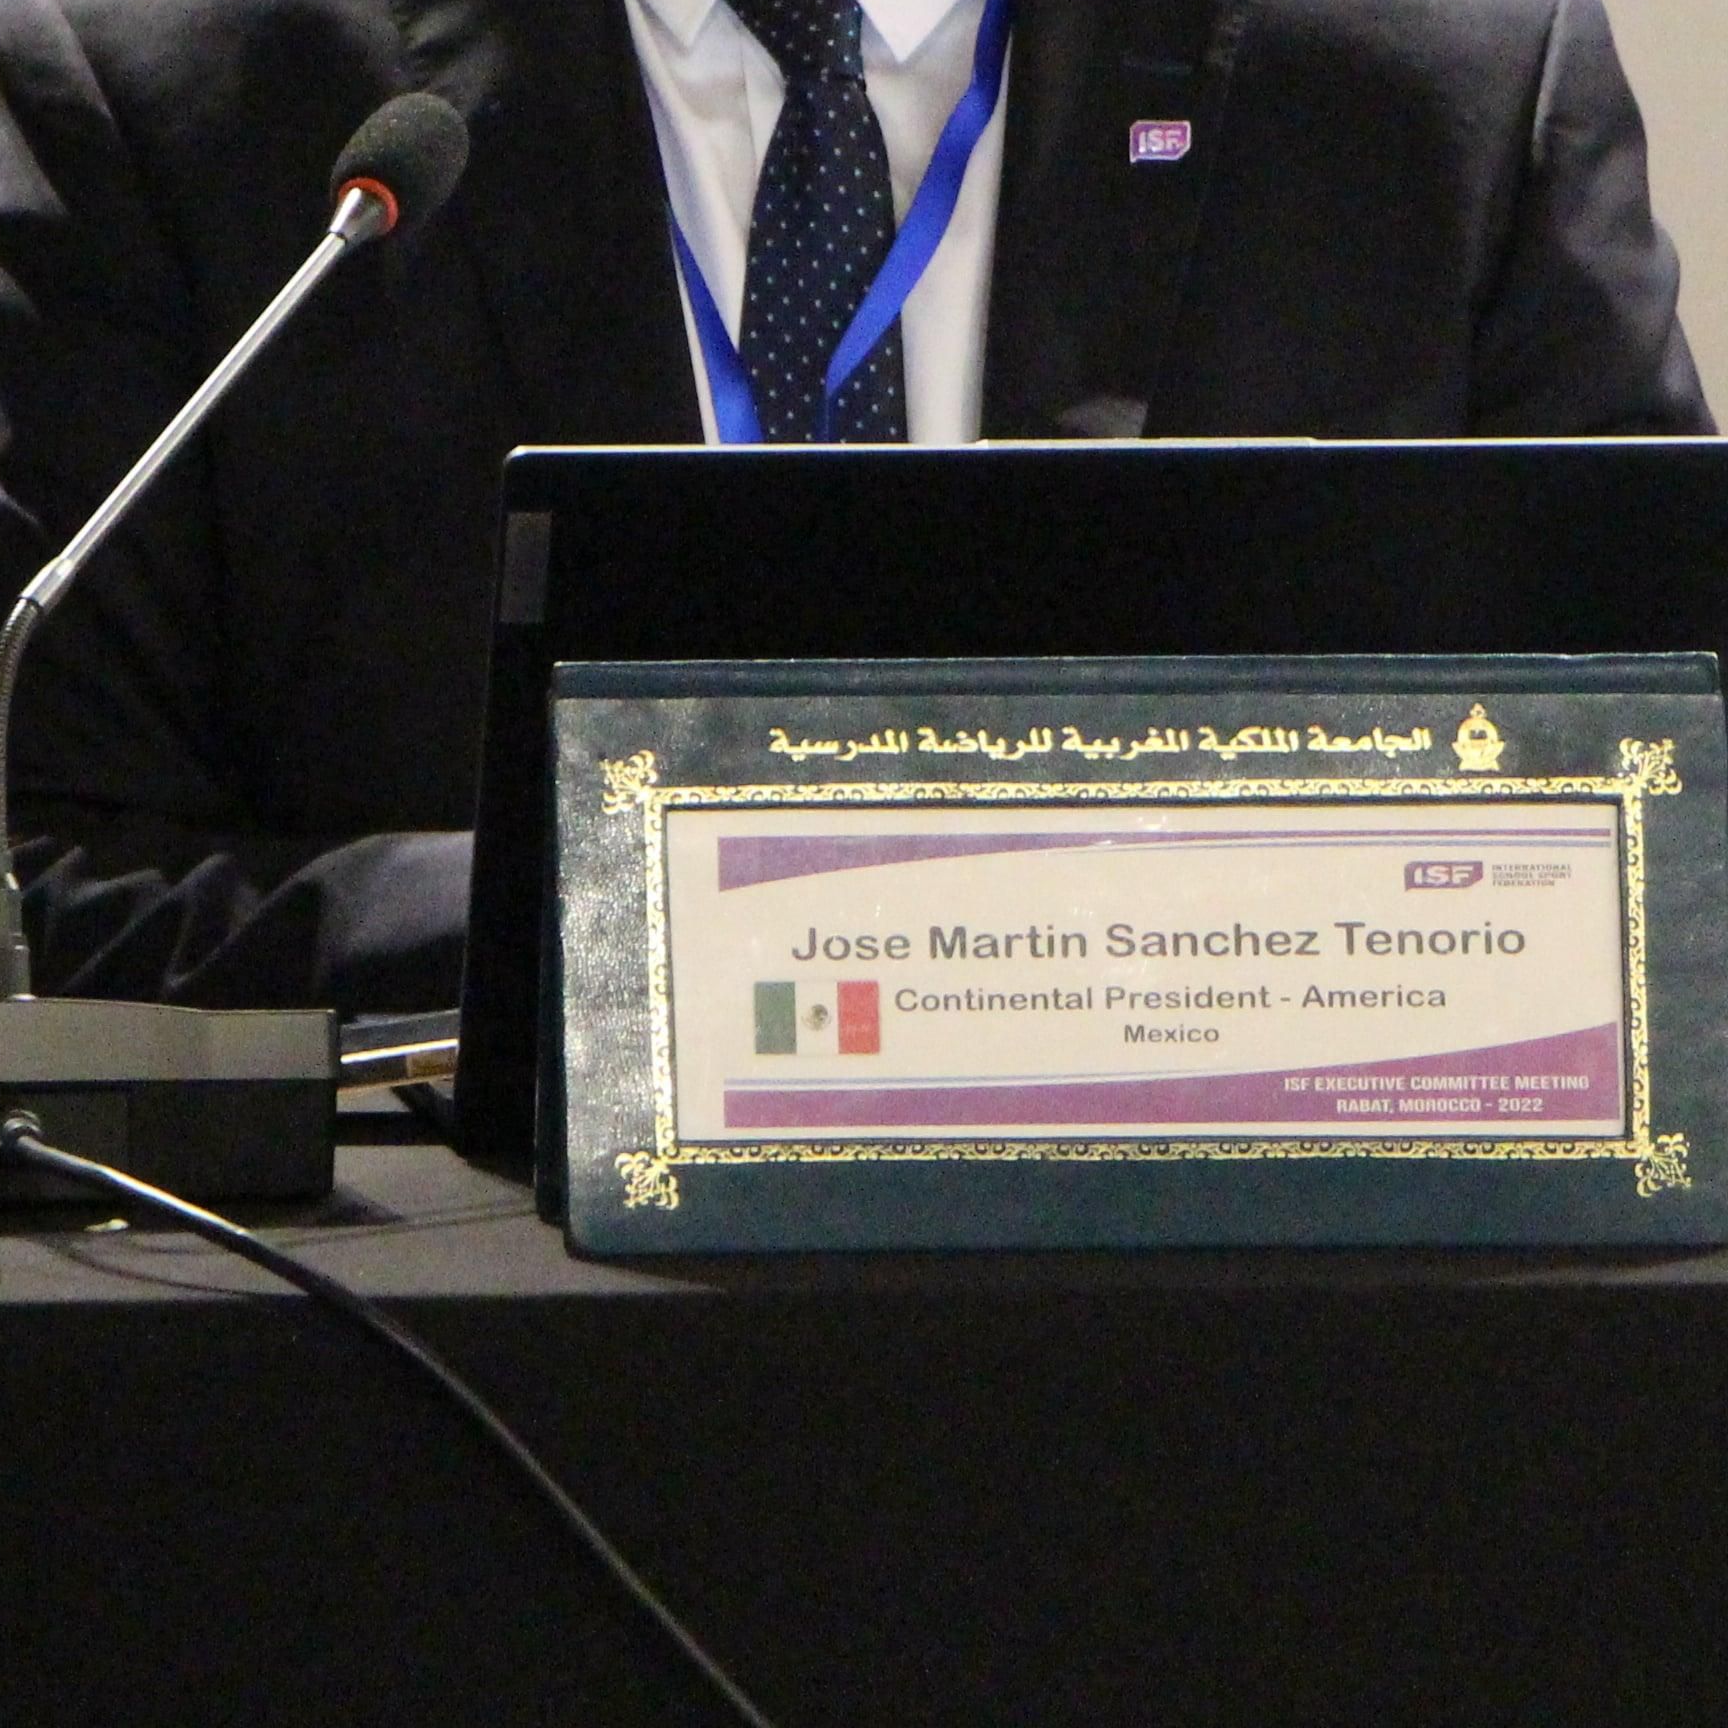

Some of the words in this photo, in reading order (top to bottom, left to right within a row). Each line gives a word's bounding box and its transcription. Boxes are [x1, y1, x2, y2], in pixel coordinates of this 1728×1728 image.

[1138, 127, 1183, 154] ISF
[769, 728, 908, 762] المدرسية
[916, 726, 1053, 761] للرياضة
[1061, 725, 1190, 761] المغربية
[1198, 725, 1300, 761] الملكية
[1307, 723, 1432, 759] الجامعة
[1414, 864, 1473, 885] ISF
[792, 926, 911, 961] Jose
[929, 924, 1088, 960] Martin
[1105, 922, 1322, 958] Sanchez
[1333, 920, 1526, 956] Tenorio
[894, 987, 1093, 1012] Continental
[1104, 985, 1273, 1010] President
[1301, 984, 1447, 1008] America
[1123, 1023, 1220, 1044] Mexico
[1284, 1076, 1310, 1092] ISF
[1314, 1076, 1406, 1091] EXECUTIVE
[1410, 1075, 1511, 1091] COMMITTEE
[1514, 1074, 1590, 1090] MEETING
[1337, 1098, 1394, 1114] RABAT,
[1399, 1098, 1481, 1113] MOROCCO
[1498, 1097, 1544, 1112] 2022
